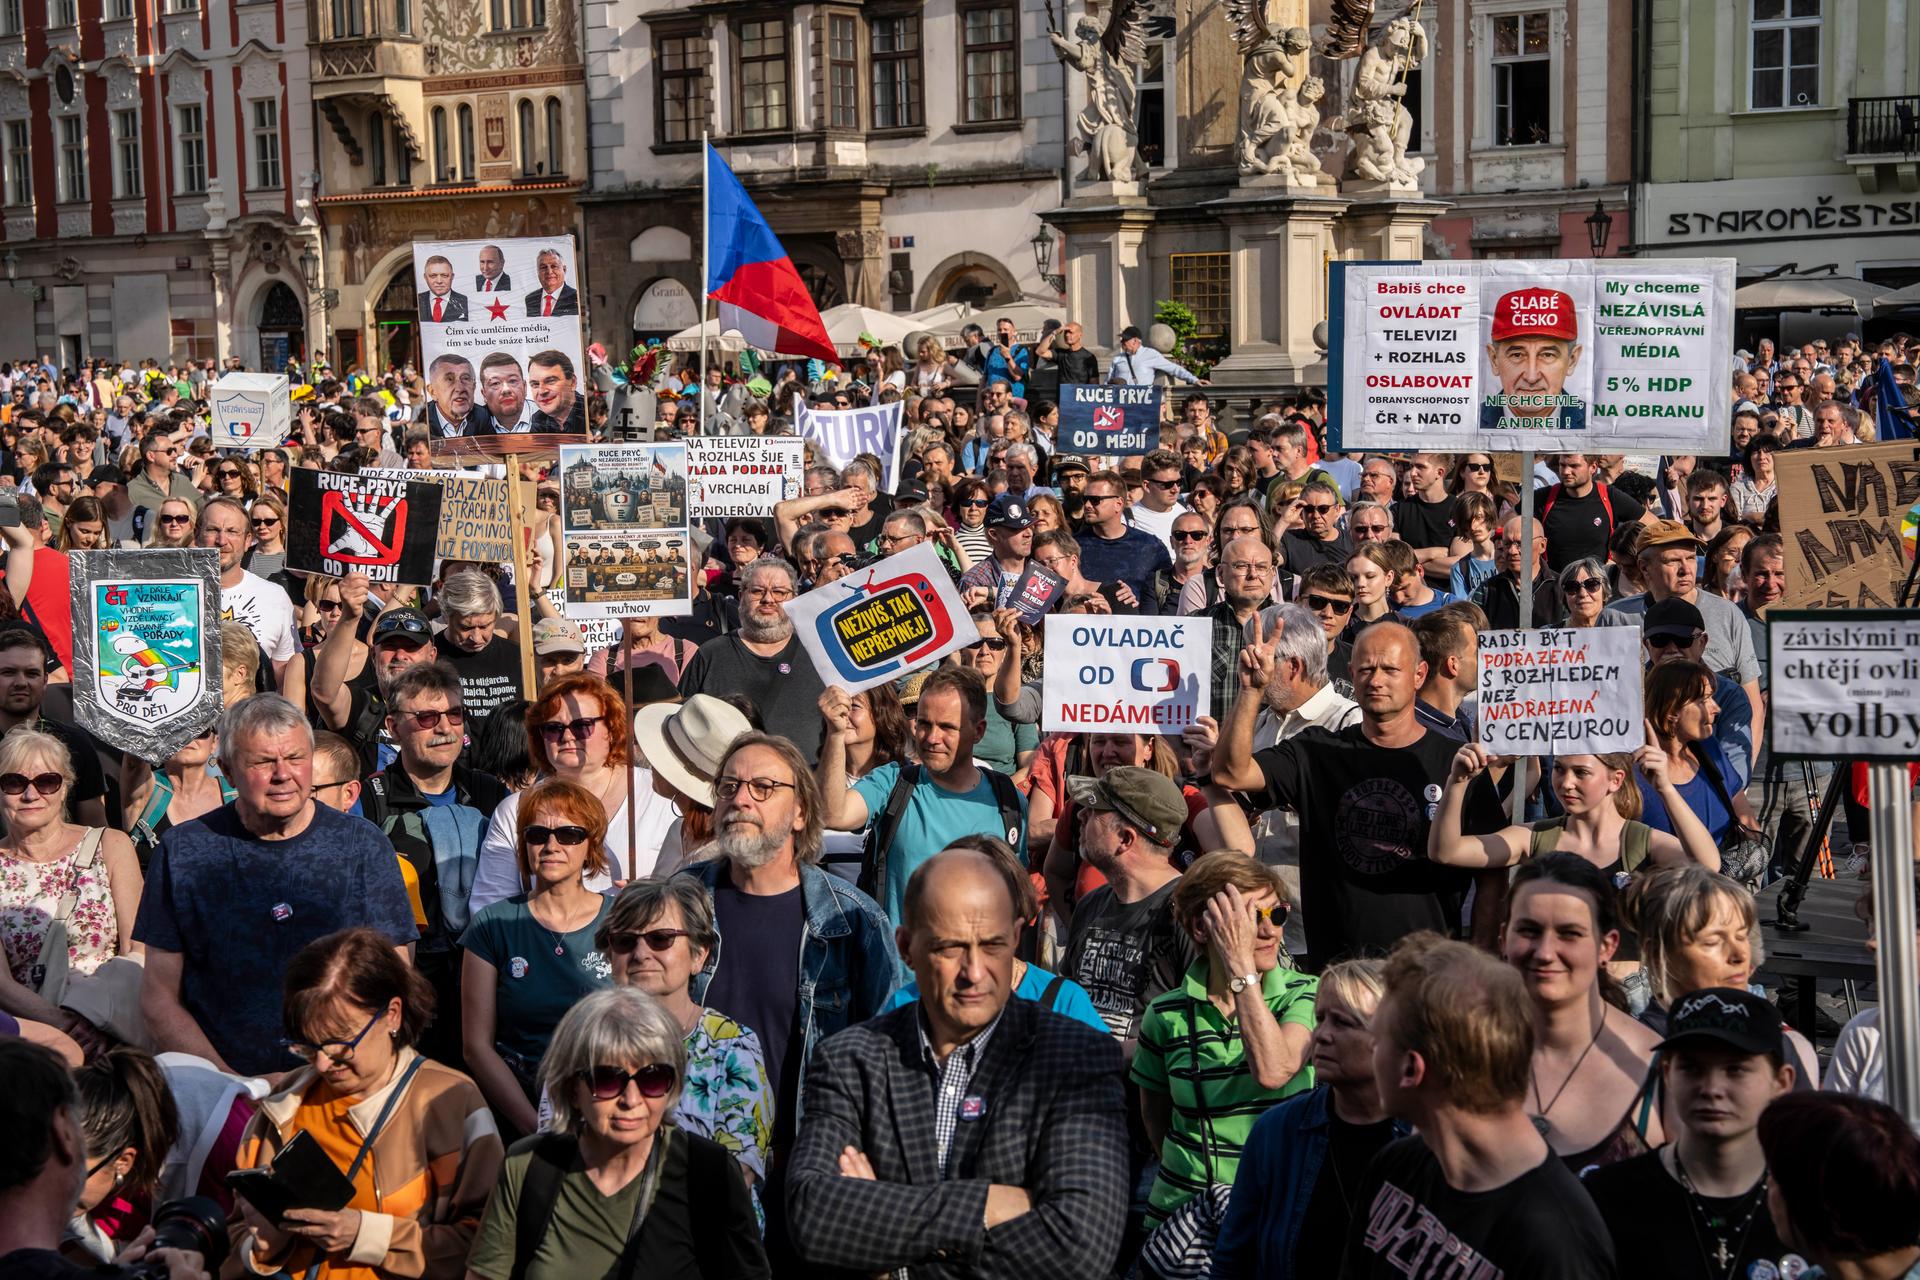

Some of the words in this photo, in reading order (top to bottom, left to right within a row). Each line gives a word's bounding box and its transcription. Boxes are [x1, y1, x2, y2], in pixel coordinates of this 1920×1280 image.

[1377, 282, 1422, 294] Babiš
[1427, 282, 1466, 294] chce
[1606, 281, 1629, 296] My
[1634, 281, 1700, 293] chceme
[1510, 292, 1559, 310] SLABÉ
[1380, 303, 1462, 319] OVLÁDAT
[1600, 302, 1705, 317] NEZÁVISLÁ
[1512, 310, 1558, 326] ČESKO
[445, 325, 464, 335] Čím
[466, 326, 478, 334] víc
[480, 325, 519, 334] umlčíme
[521, 324, 551, 333] média,
[1383, 329, 1457, 341] TELEVIZI
[1599, 325, 1705, 336] VEŘEJNOPRÁVNÍ
[475, 338, 496, 346] bude
[499, 337, 522, 345] snáze
[525, 335, 549, 344] krást!
[1388, 352, 1466, 363] ROZHLAS
[1621, 342, 1680, 358] MÉDIA
[1366, 375, 1473, 388] OSLABOVAT
[1647, 377, 1692, 392] HDP
[1075, 387, 1113, 403] RUCE
[1119, 384, 1153, 404] PRYČ
[1368, 396, 1470, 405] OBRANYSCHOPNOST
[1375, 410, 1398, 424] ČR
[1417, 413, 1462, 425] NATO
[1593, 404, 1619, 417] NA
[1625, 404, 1704, 418] OBRANU
[1497, 416, 1561, 429] ANDREI
[709, 438, 760, 449] TELEVIZI
[1073, 430, 1099, 448] OD
[1106, 427, 1149, 449] MÉDIÍ
[599, 450, 620, 458] RUCE
[622, 449, 641, 457] PRYČ
[699, 451, 755, 462] ROZHLAS
[761, 449, 784, 462] ŠIJE
[688, 463, 727, 475] VLÁDA
[732, 464, 787, 475] PODRAZ!
[317, 472, 358, 494] RUCE
[367, 479, 407, 497] PRYČ
[708, 481, 770, 495] VRCHLABÍ
[323, 558, 342, 576] OD
[105, 585, 128, 605] ČT
[137, 590, 188, 603] VZNIKAJÍ
[606, 605, 650, 614] TRUTNOV
[838, 600, 895, 640] NEŽIVÍŠ,
[887, 592, 917, 618] TAK
[850, 615, 929, 663] NEPŘEPÍNEJ!
[1072, 624, 1185, 649] OVLADAČ
[1478, 629, 1526, 649] RADŠI
[1540, 629, 1577, 648] BÝT
[1783, 627, 1896, 646] závislými
[1078, 665, 1115, 685] OD
[1482, 669, 1493, 687] S
[1501, 665, 1619, 685] ROZHLEDEM
[1784, 658, 1860, 685] chtějí
[1869, 659, 1920, 680] ovli
[1481, 685, 1518, 704] NEŽ
[116, 700, 137, 714] PRO
[142, 703, 168, 718] DĚTI
[1060, 699, 1192, 725] NEDÁME!!!
[1482, 723, 1496, 743] S
[1505, 718, 1630, 742] CENZUROU
